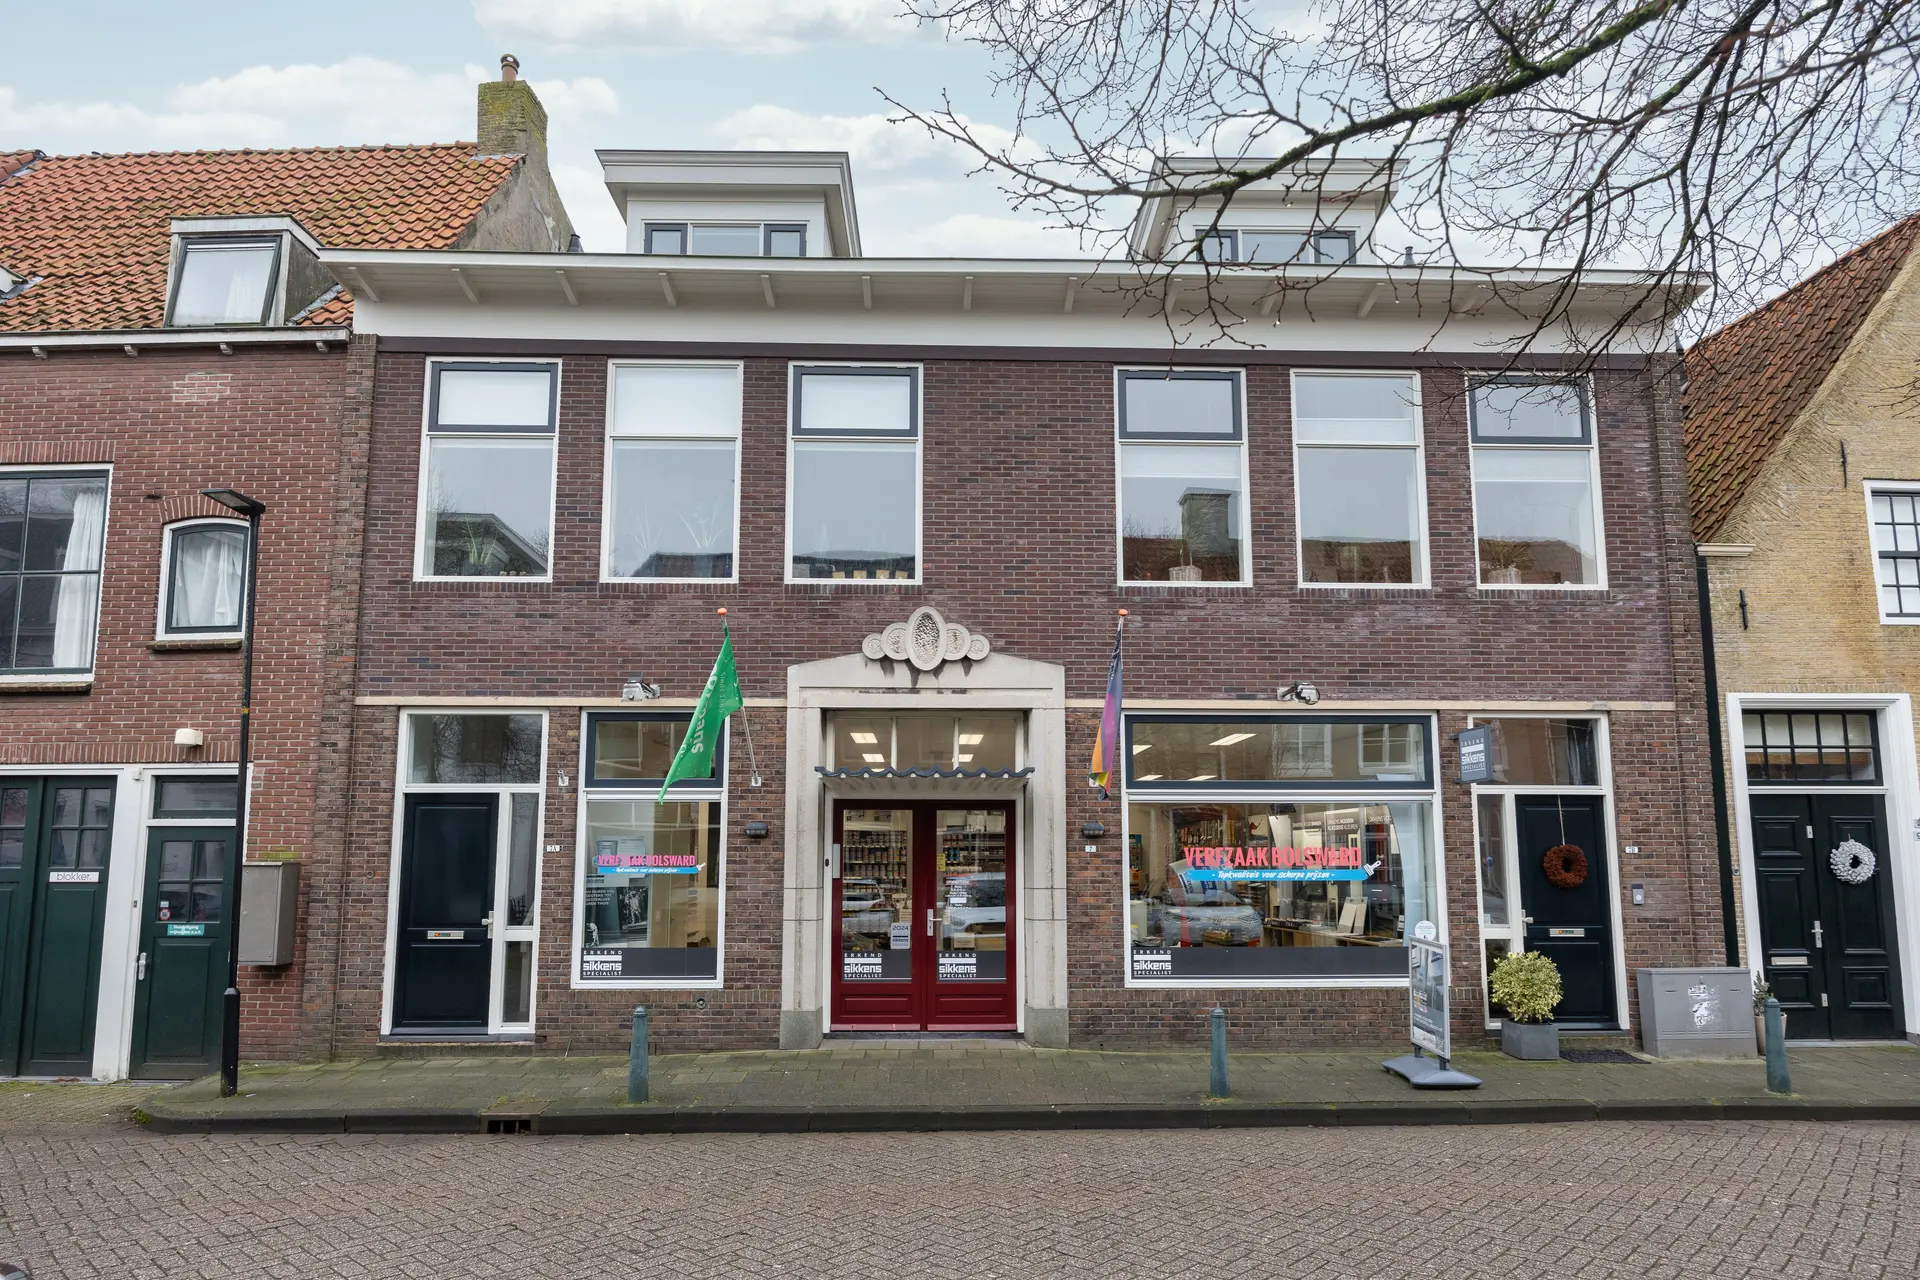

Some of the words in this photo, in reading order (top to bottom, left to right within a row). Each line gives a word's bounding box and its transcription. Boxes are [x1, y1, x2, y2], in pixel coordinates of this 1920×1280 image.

[1461, 752, 1485, 765] sikkens
[598, 855, 644, 867] VERFZAAK
[646, 855, 696, 866] BOLSWARD
[1184, 846, 1271, 867] VERFZAAK
[1272, 847, 1361, 867] BOLSWARD
[583, 961, 622, 970] sikkens
[844, 964, 882, 973] sikkens
[939, 964, 976, 973] sikkens
[1134, 961, 1172, 970] sikkens
